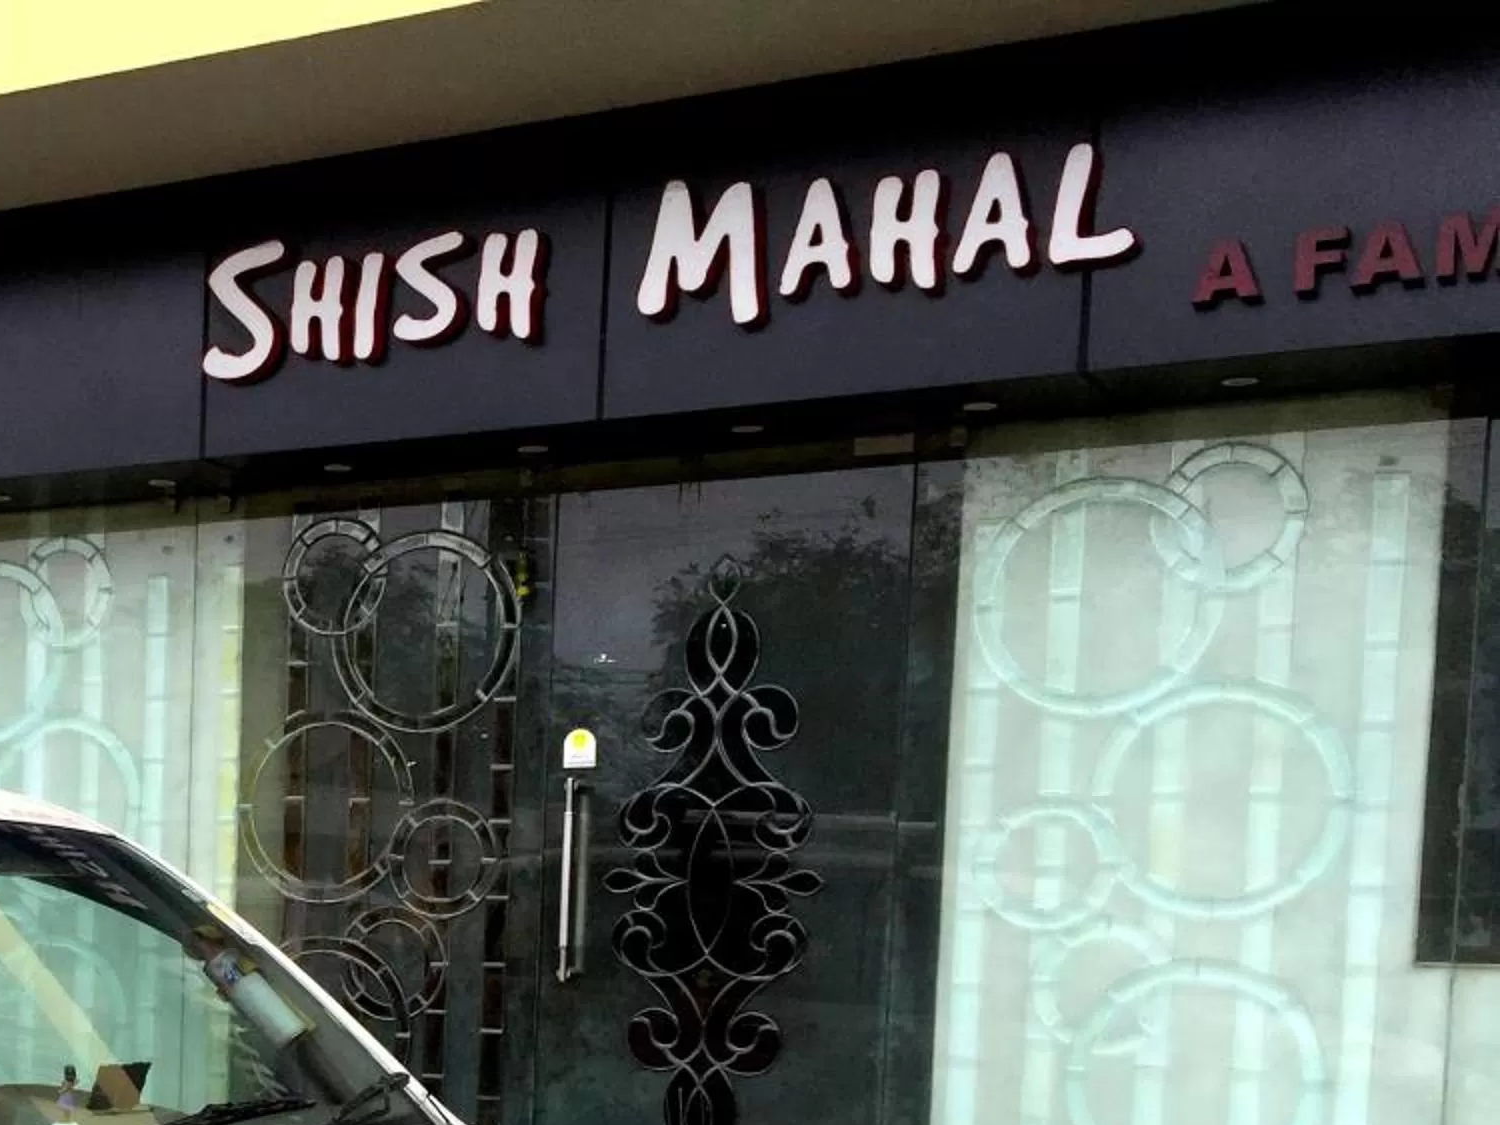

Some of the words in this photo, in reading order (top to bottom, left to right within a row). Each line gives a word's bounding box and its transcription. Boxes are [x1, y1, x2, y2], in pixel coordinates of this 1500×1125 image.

[202, 228, 546, 381] SHISH
[637, 143, 1137, 326] MAHAL
[1191, 236, 1264, 310] A
